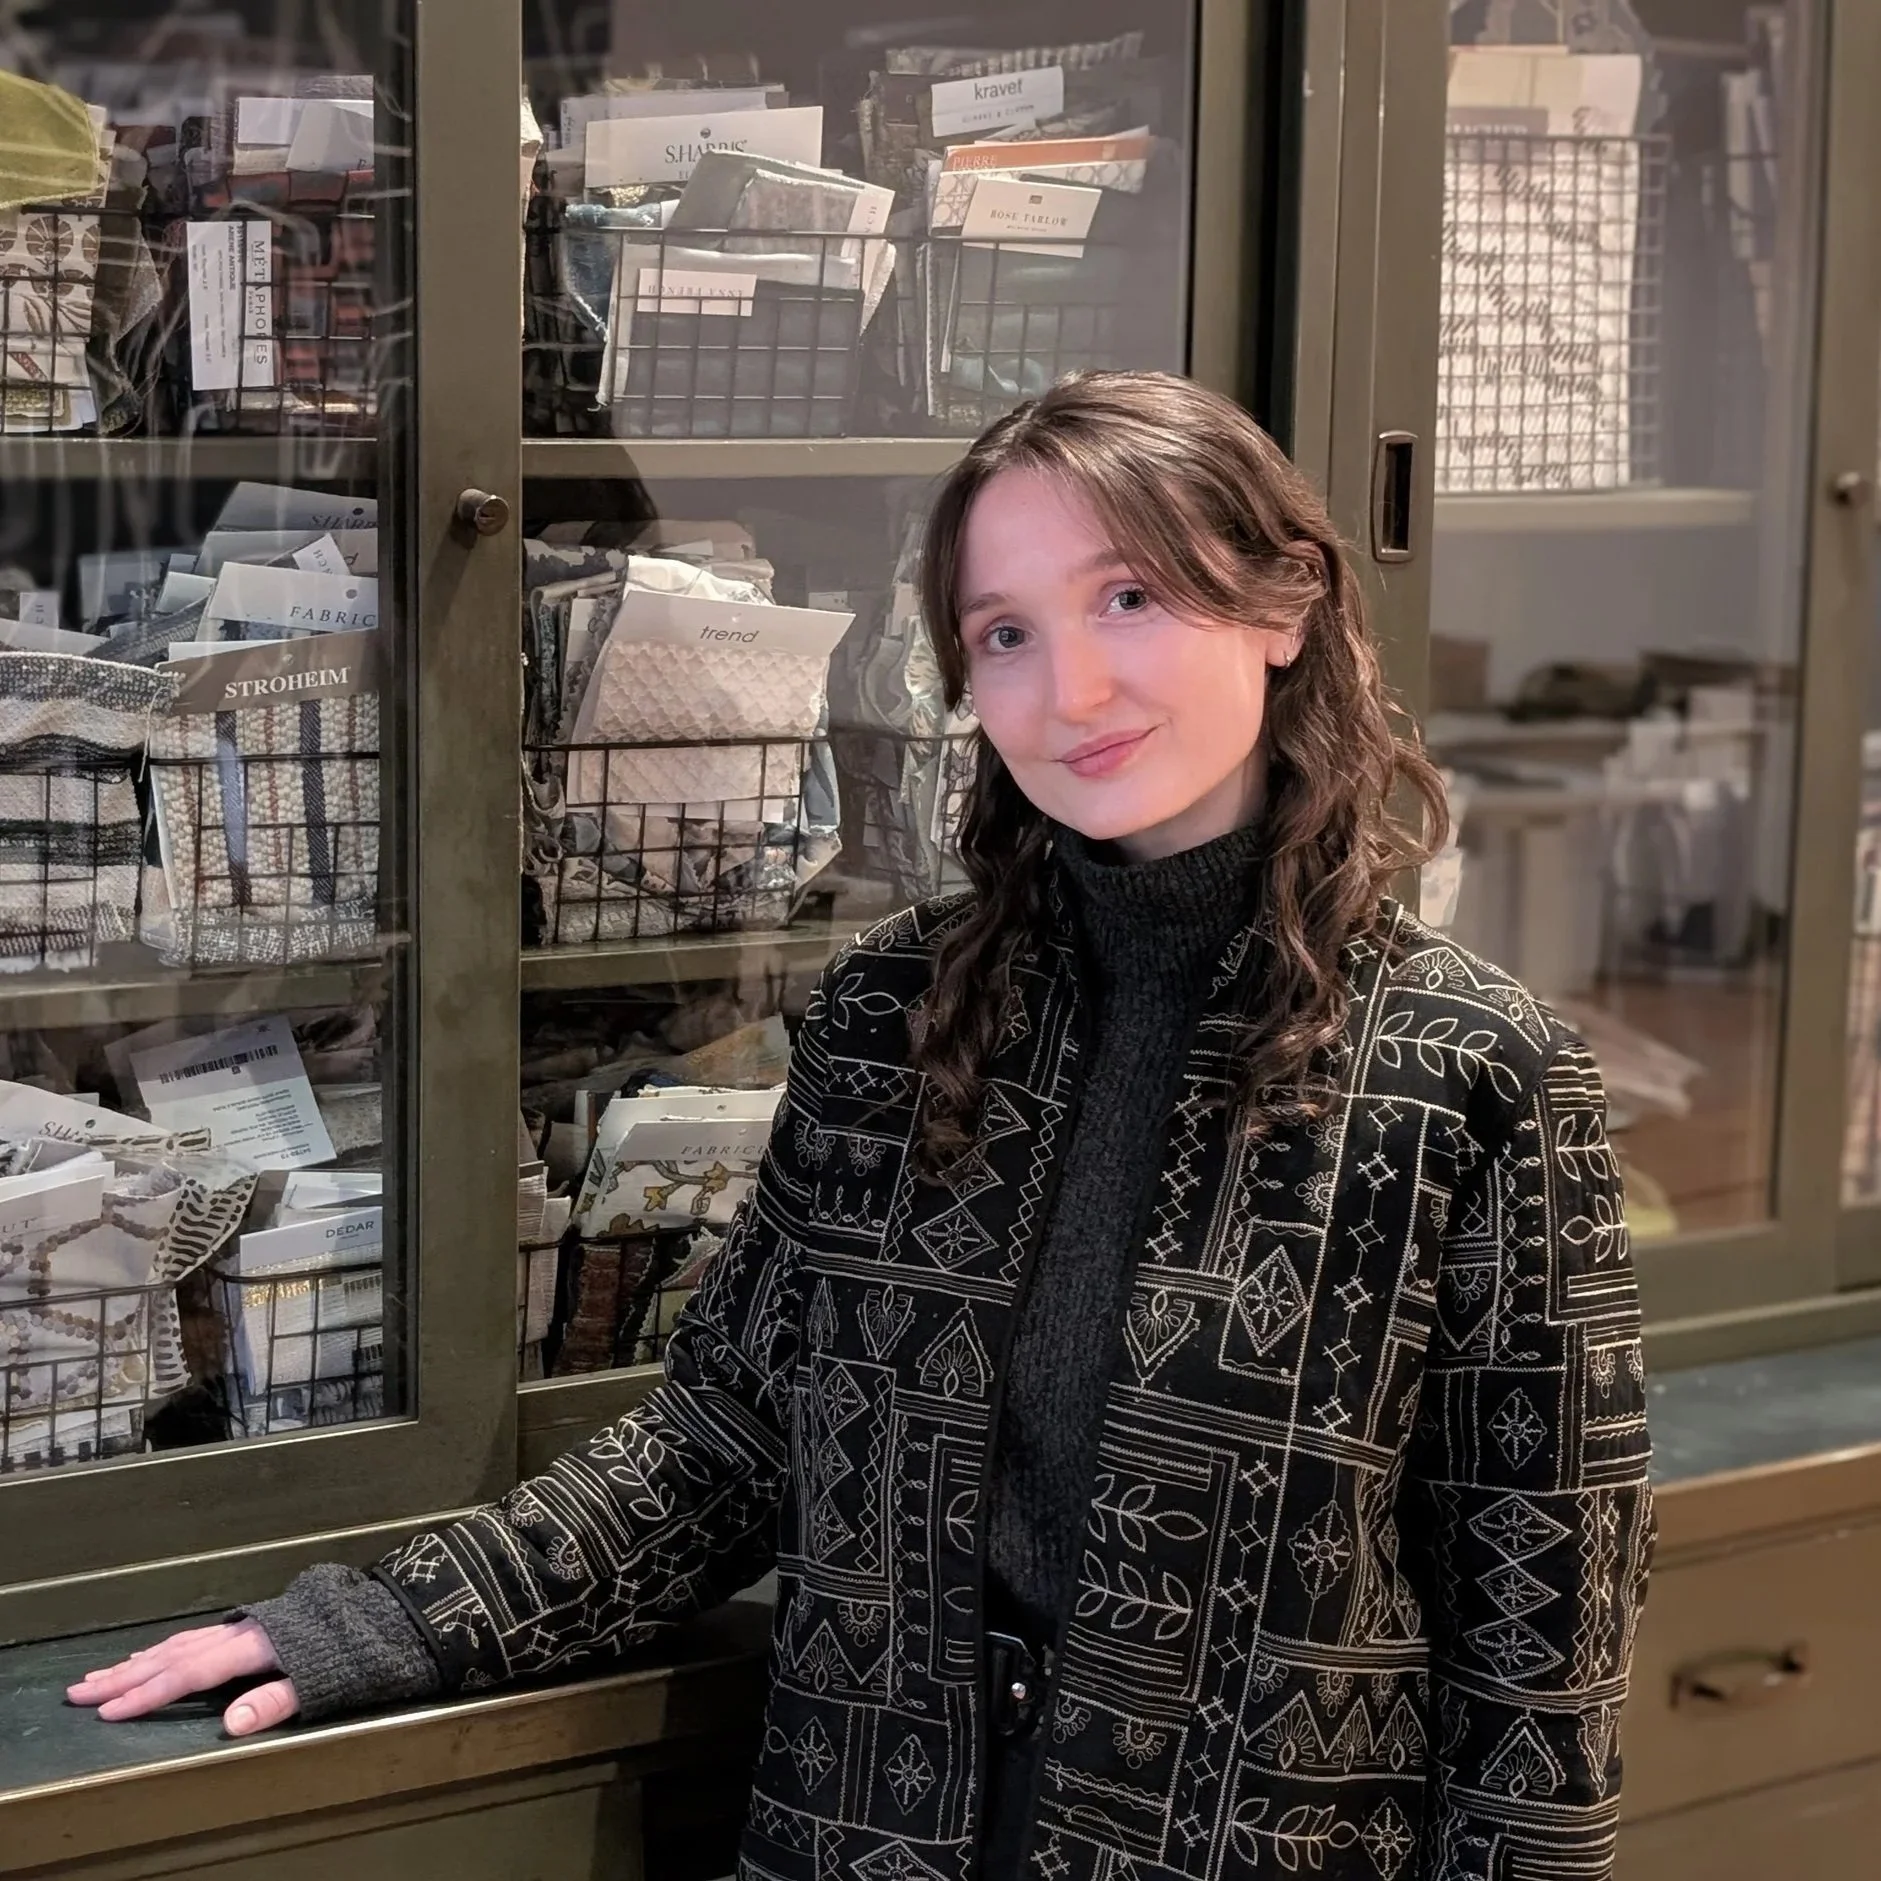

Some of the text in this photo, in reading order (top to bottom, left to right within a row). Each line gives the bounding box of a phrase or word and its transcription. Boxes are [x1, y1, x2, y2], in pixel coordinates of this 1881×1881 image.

[974, 77, 1023, 100] kravet
[990, 209, 1068, 226] ROSE TARLOW
[700, 625, 760, 643] trend
[224, 666, 349, 699] STROHEIM
[325, 1220, 375, 1239] DEDAR
